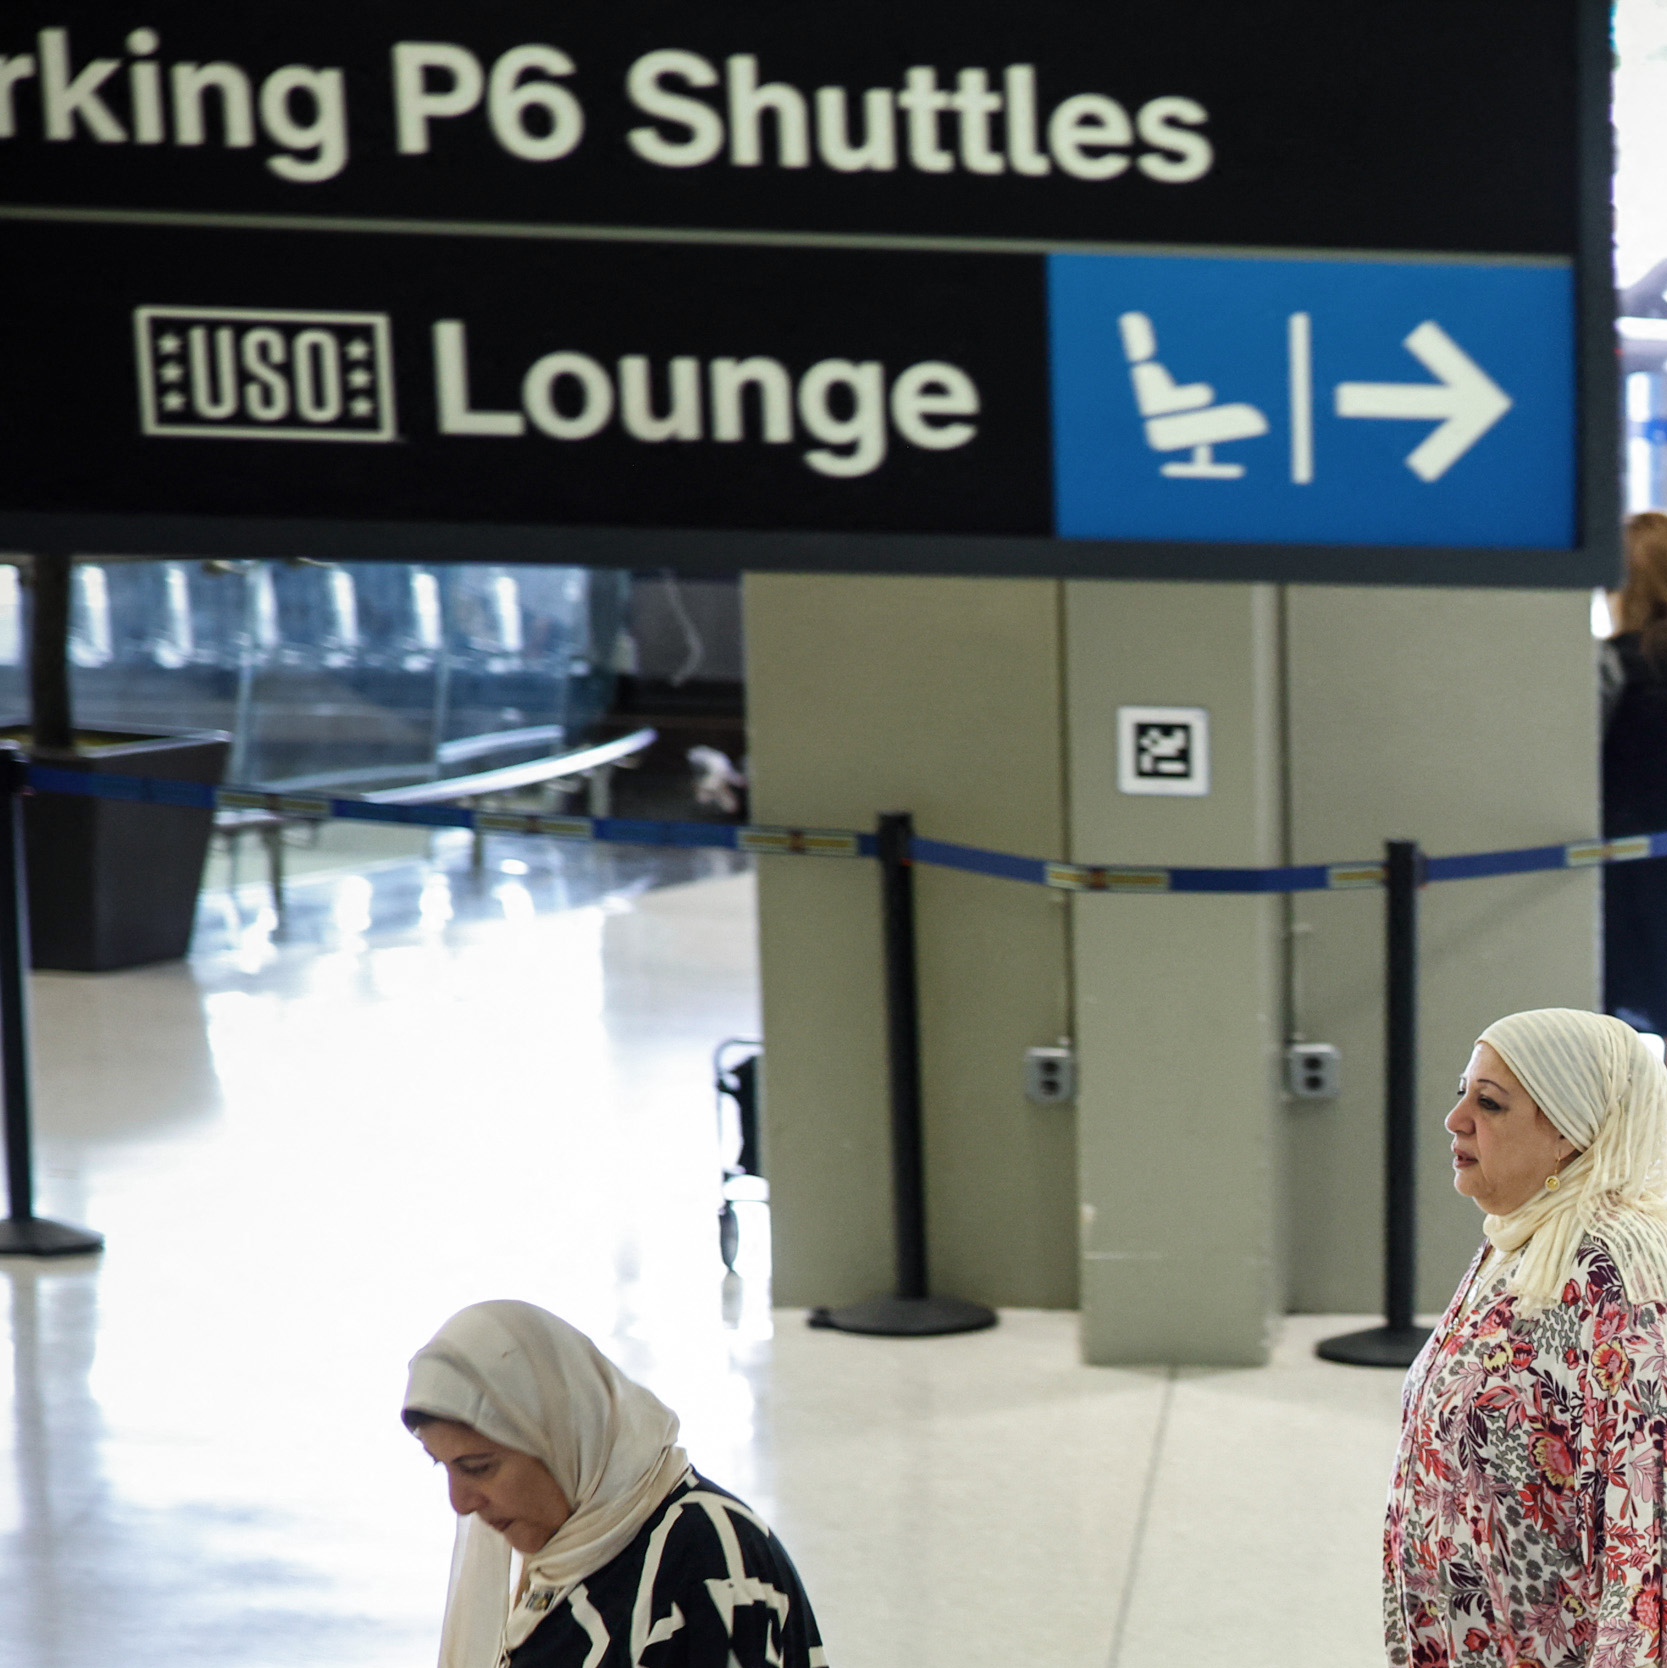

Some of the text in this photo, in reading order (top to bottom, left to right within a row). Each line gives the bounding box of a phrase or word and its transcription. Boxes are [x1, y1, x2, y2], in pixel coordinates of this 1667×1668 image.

[0, 27, 1212, 183] rking P6 Shuttles
[189, 326, 342, 422] USO
[433, 319, 980, 478] Lounge
